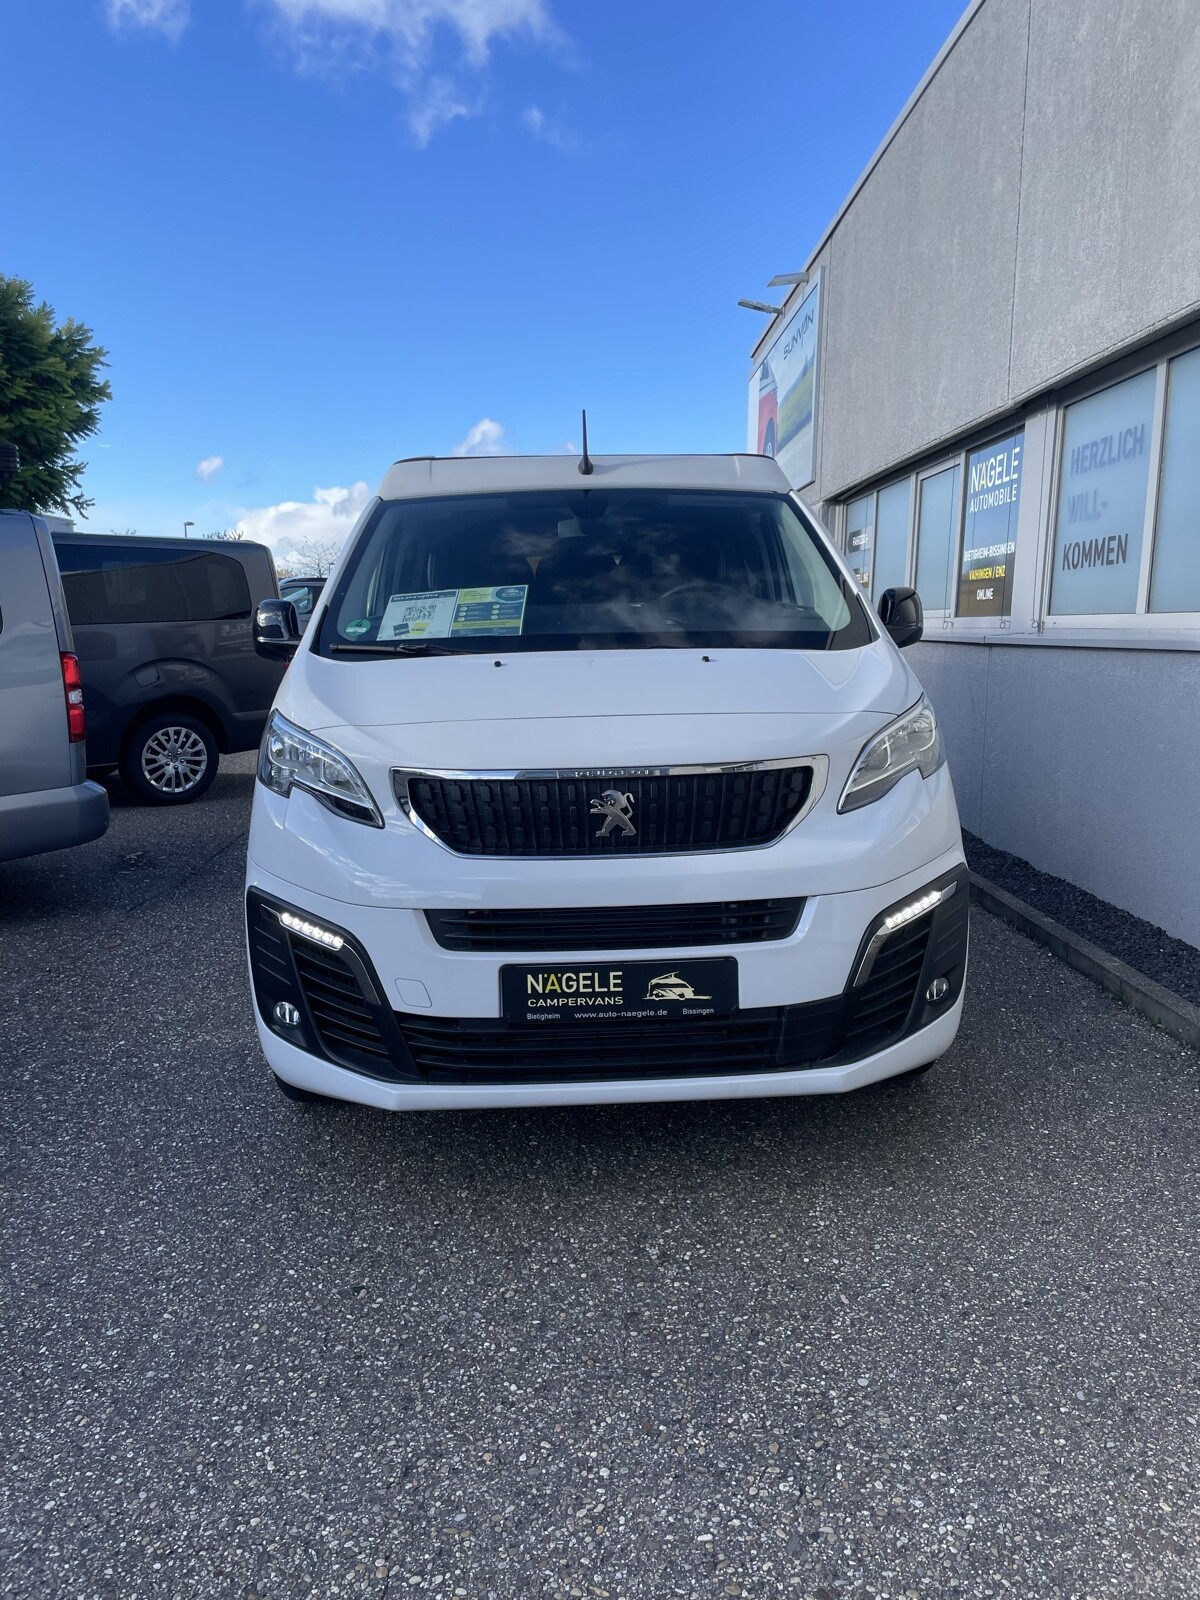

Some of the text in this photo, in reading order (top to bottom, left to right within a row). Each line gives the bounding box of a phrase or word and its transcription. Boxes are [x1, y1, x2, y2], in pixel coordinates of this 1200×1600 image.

[1070, 423, 1146, 477] HERZLICH
[970, 446, 1021, 495] NÄGELE
[969, 483, 1018, 514] AUTOMOBILE
[1067, 489, 1108, 525] WILL-
[1061, 533, 1129, 571] KOMMEN
[976, 587, 994, 600] ONLINE
[526, 971, 624, 994] NÄGELE
[526, 1007, 715, 1021] Bietigheim www.auto-naegele.de Bissingen
[527, 996, 624, 1008] CAMPERVANS
